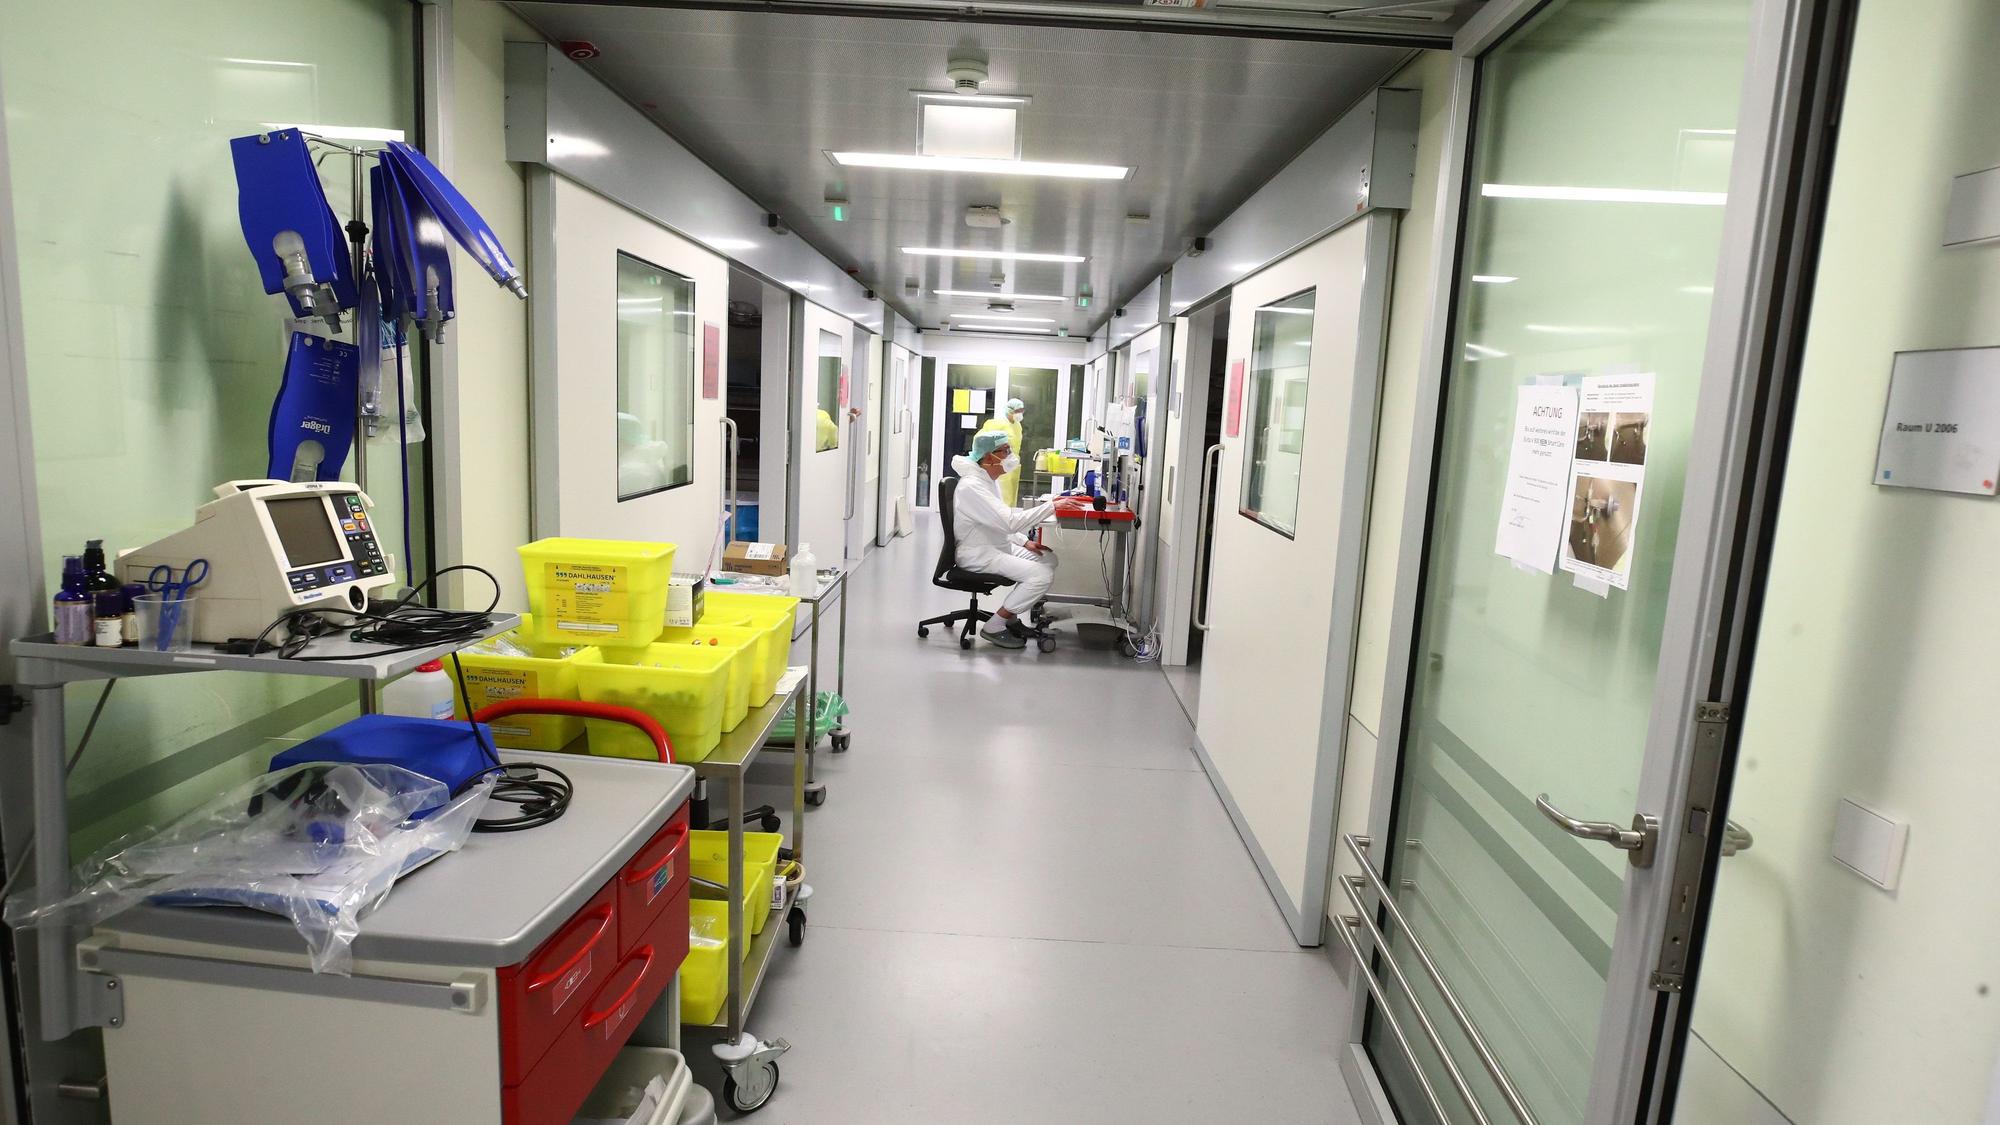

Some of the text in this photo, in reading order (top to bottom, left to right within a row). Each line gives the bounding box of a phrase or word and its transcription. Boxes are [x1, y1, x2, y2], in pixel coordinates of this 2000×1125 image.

[1533, 406, 1563, 418] ACHTUNG
[300, 420, 331, 434] Dräger
[1896, 422, 1959, 433] Raum U 2006
[568, 572, 614, 581] DAHLHAUSEN
[479, 675, 526, 685] DAHLHAUSEN
